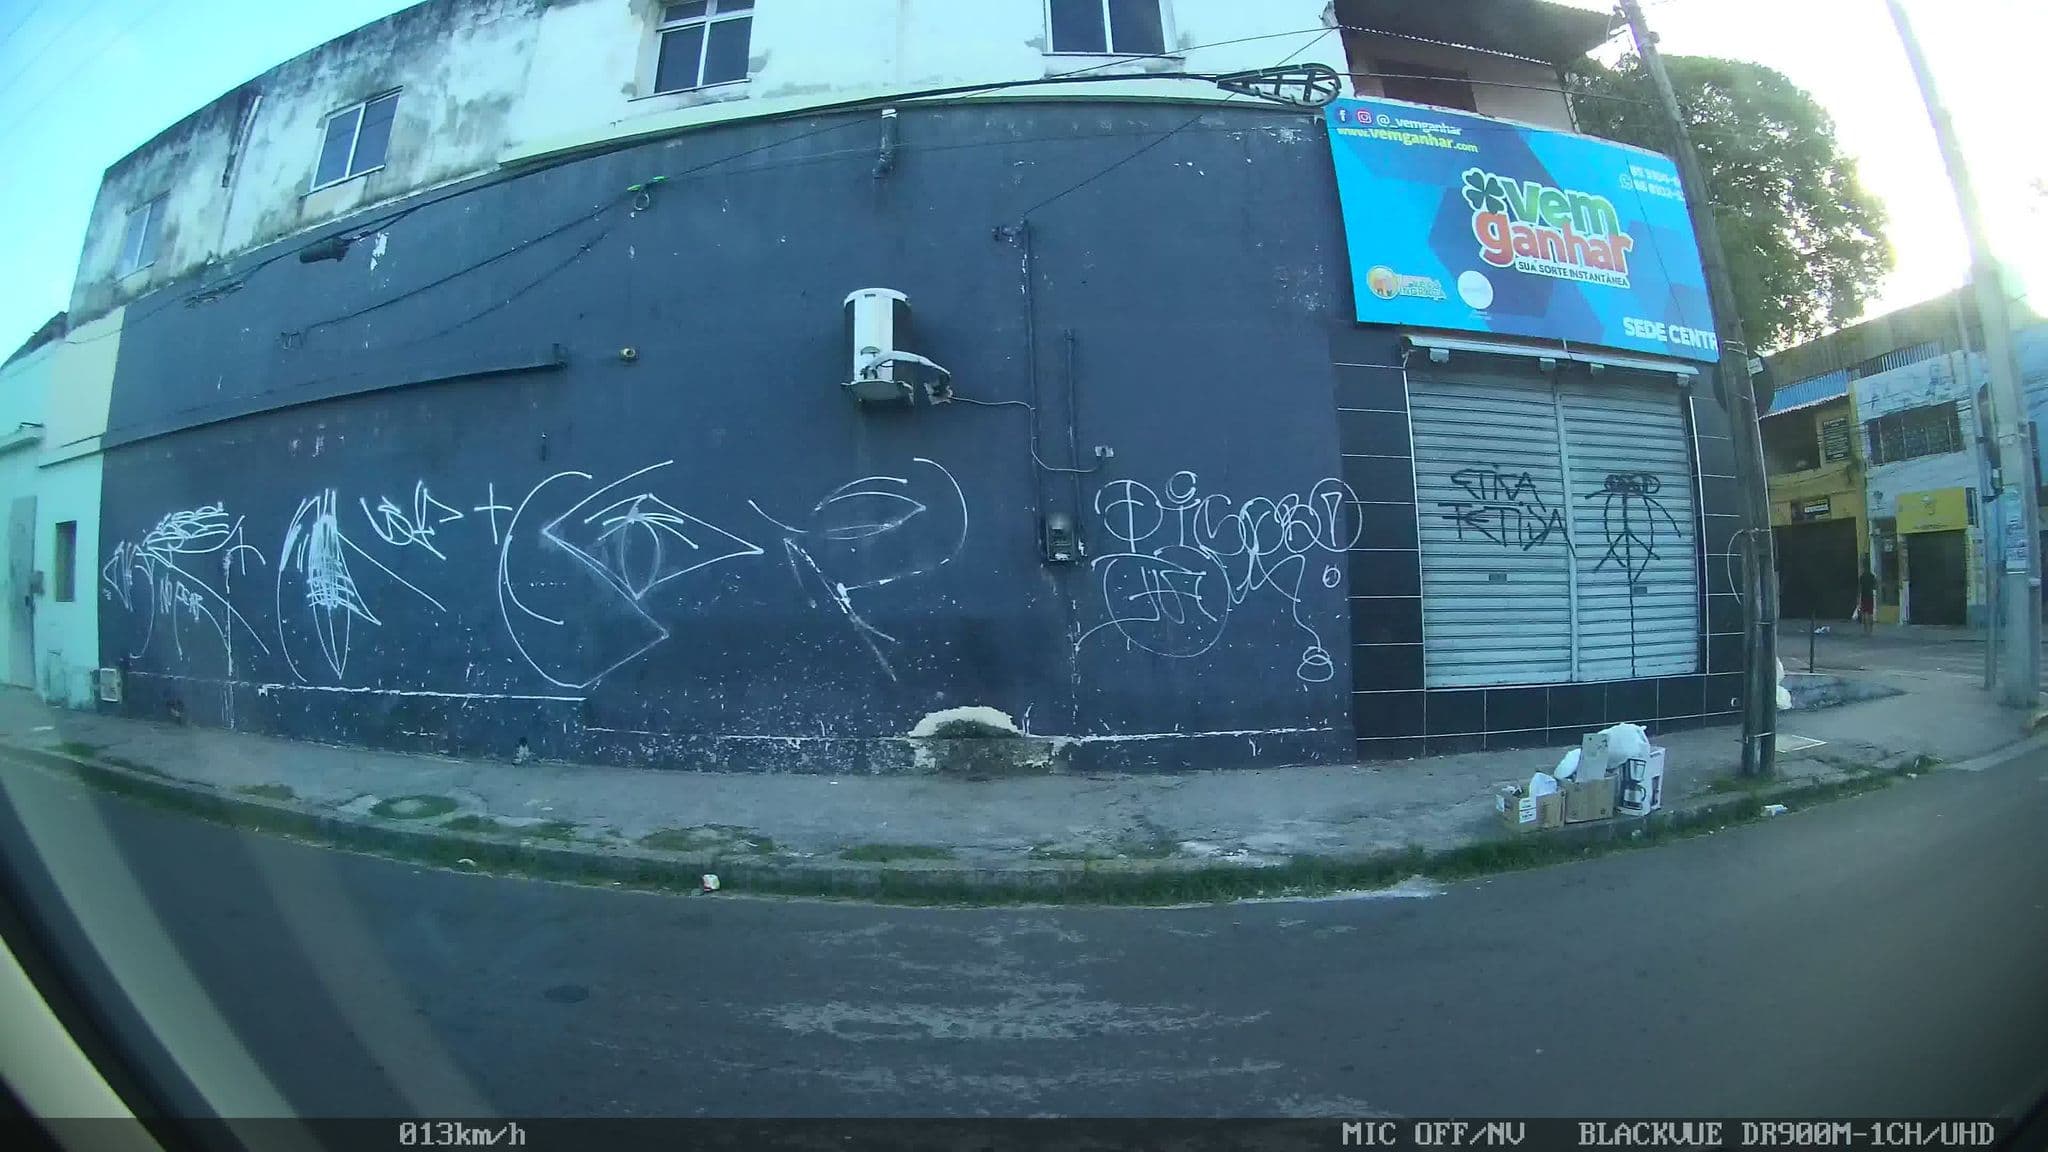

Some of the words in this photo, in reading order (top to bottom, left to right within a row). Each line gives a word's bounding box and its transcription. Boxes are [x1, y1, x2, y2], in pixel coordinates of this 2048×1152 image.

[1337, 127, 1479, 153] www.vemganhar.com
[1473, 210, 1632, 274] ganhar
[1518, 261, 1538, 272] SUA
[1538, 264, 1568, 277] SORTE
[1622, 316, 1668, 342] SEDE
